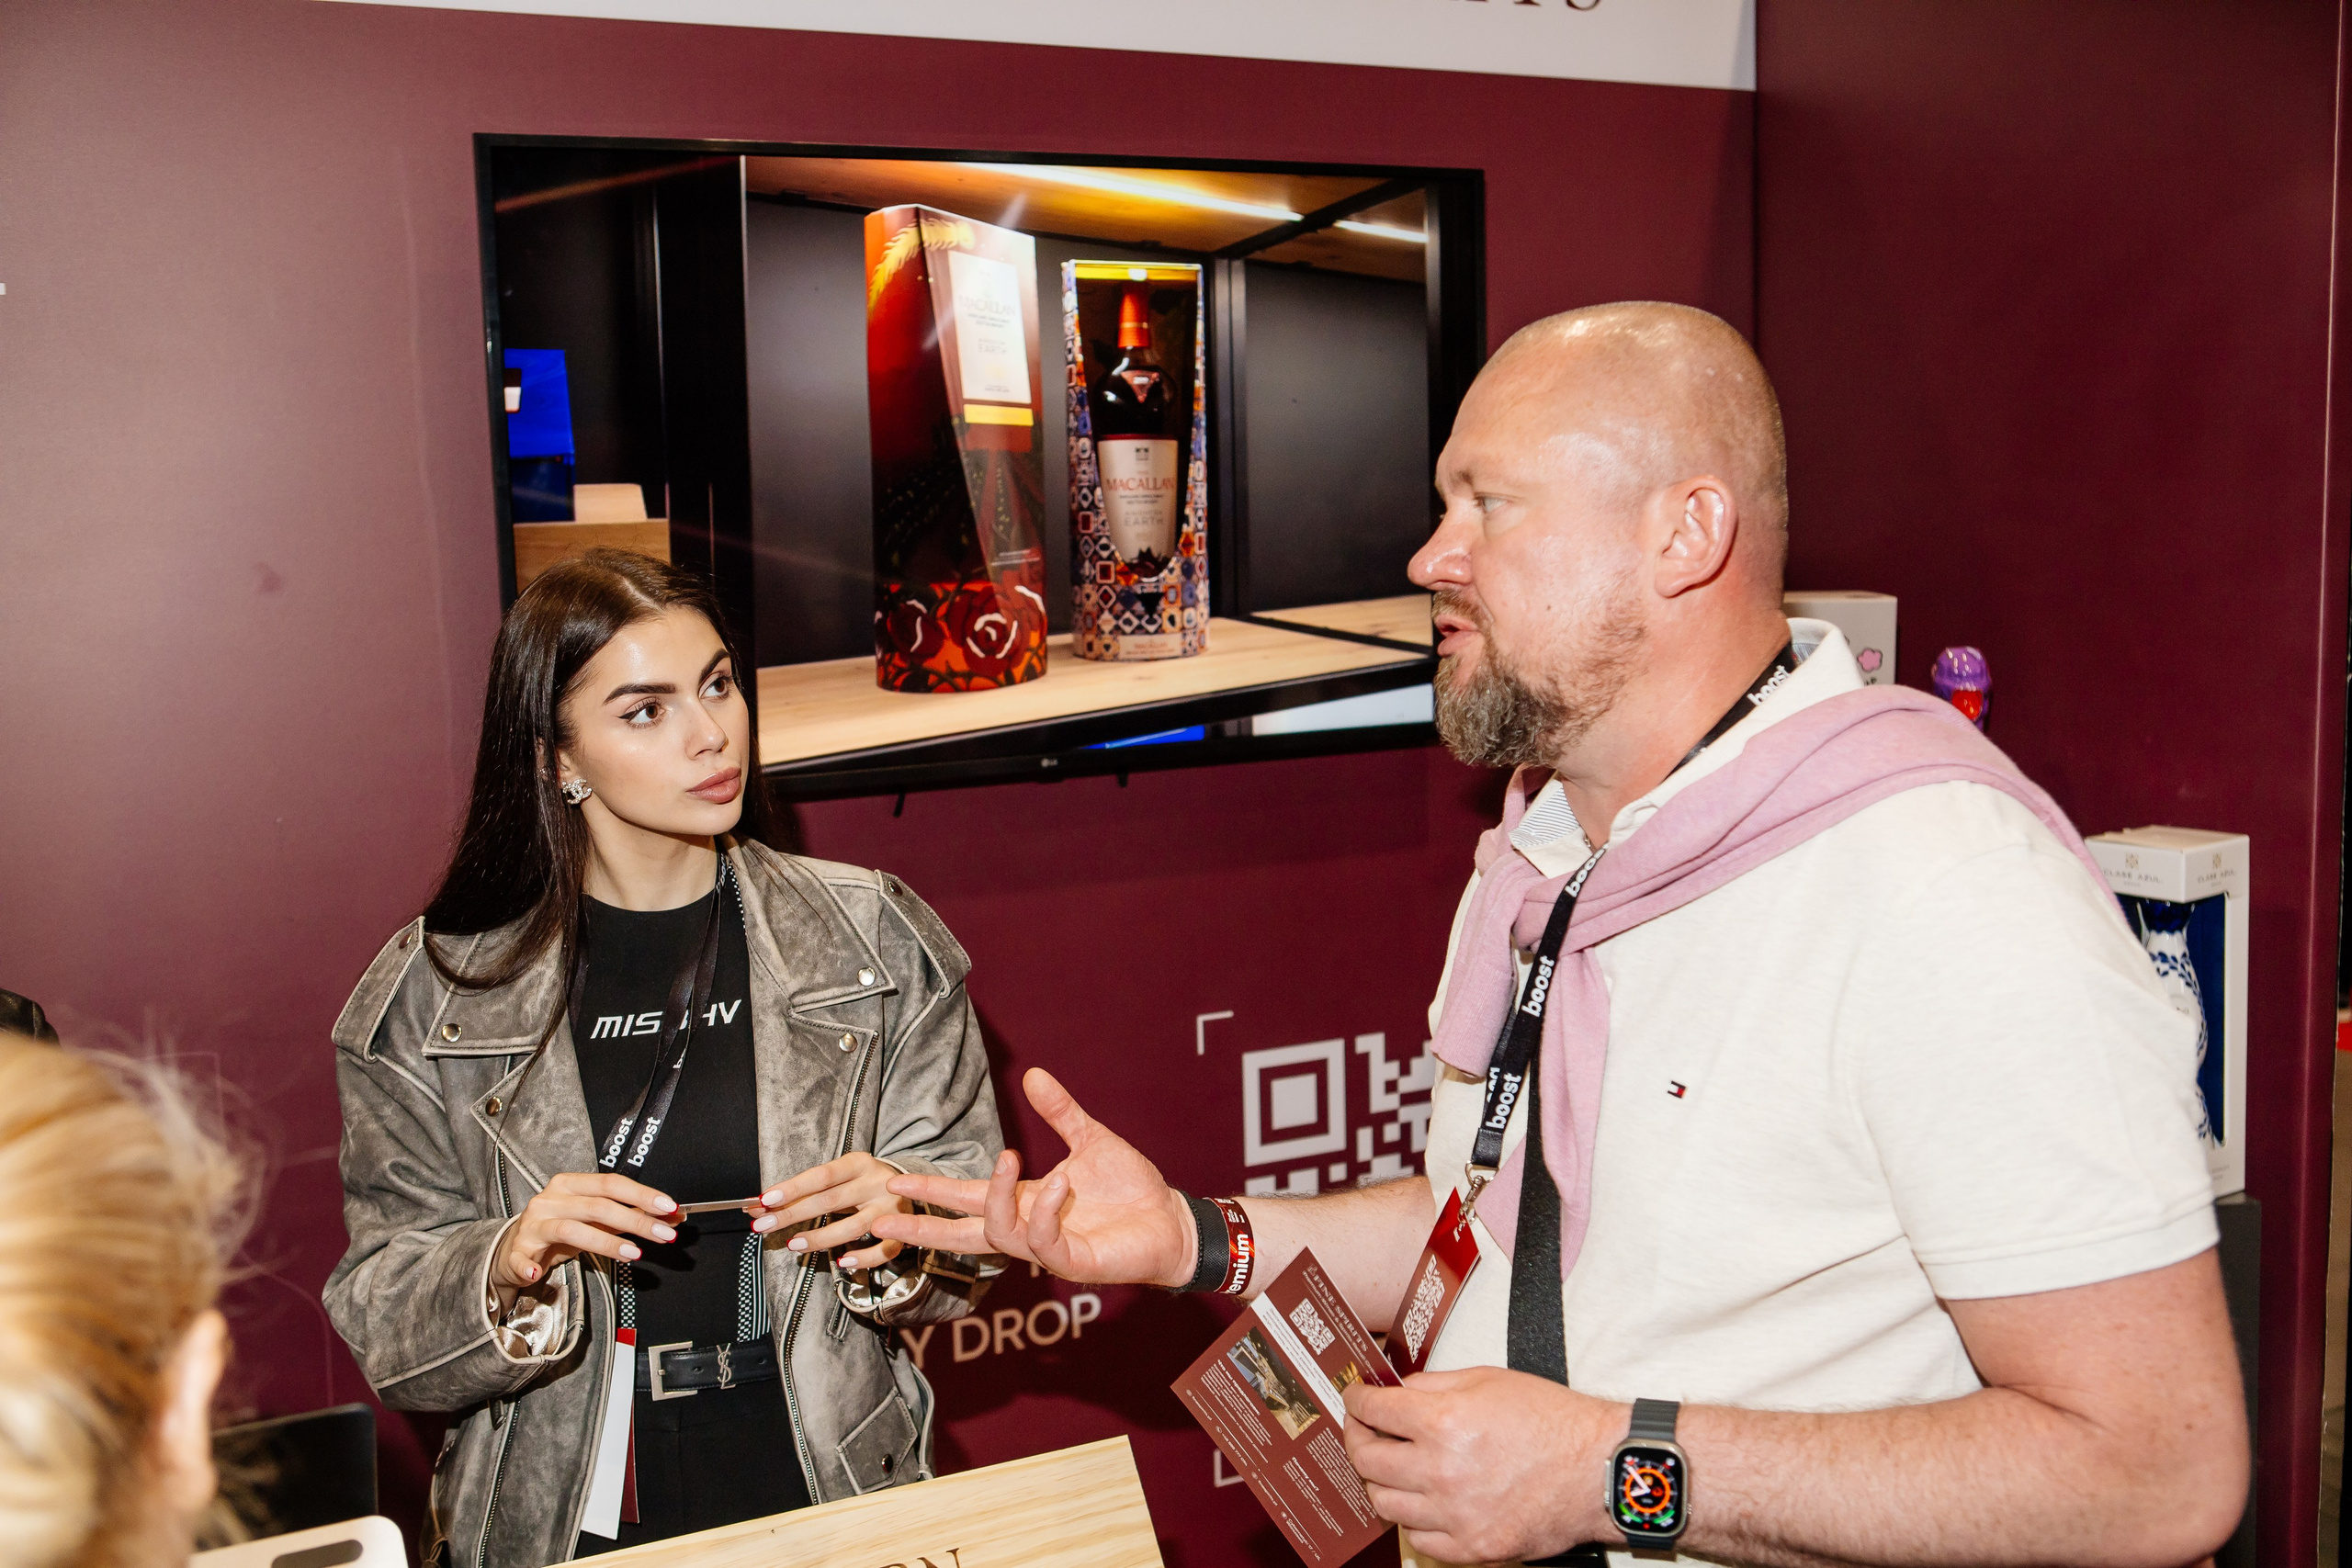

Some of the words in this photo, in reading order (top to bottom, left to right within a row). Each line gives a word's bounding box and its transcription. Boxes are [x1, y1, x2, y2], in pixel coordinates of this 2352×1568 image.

[1747, 664, 1791, 706] boost
[1521, 955, 1555, 1018] boost
[590, 998, 742, 1040] MISHV
[1485, 1072, 1522, 1130] boost
[599, 1117, 633, 1168] boost
[627, 1116, 661, 1168] boost
[952, 1292, 1102, 1363] DROP
[1333, 1303, 1369, 1353] SPIRITS
